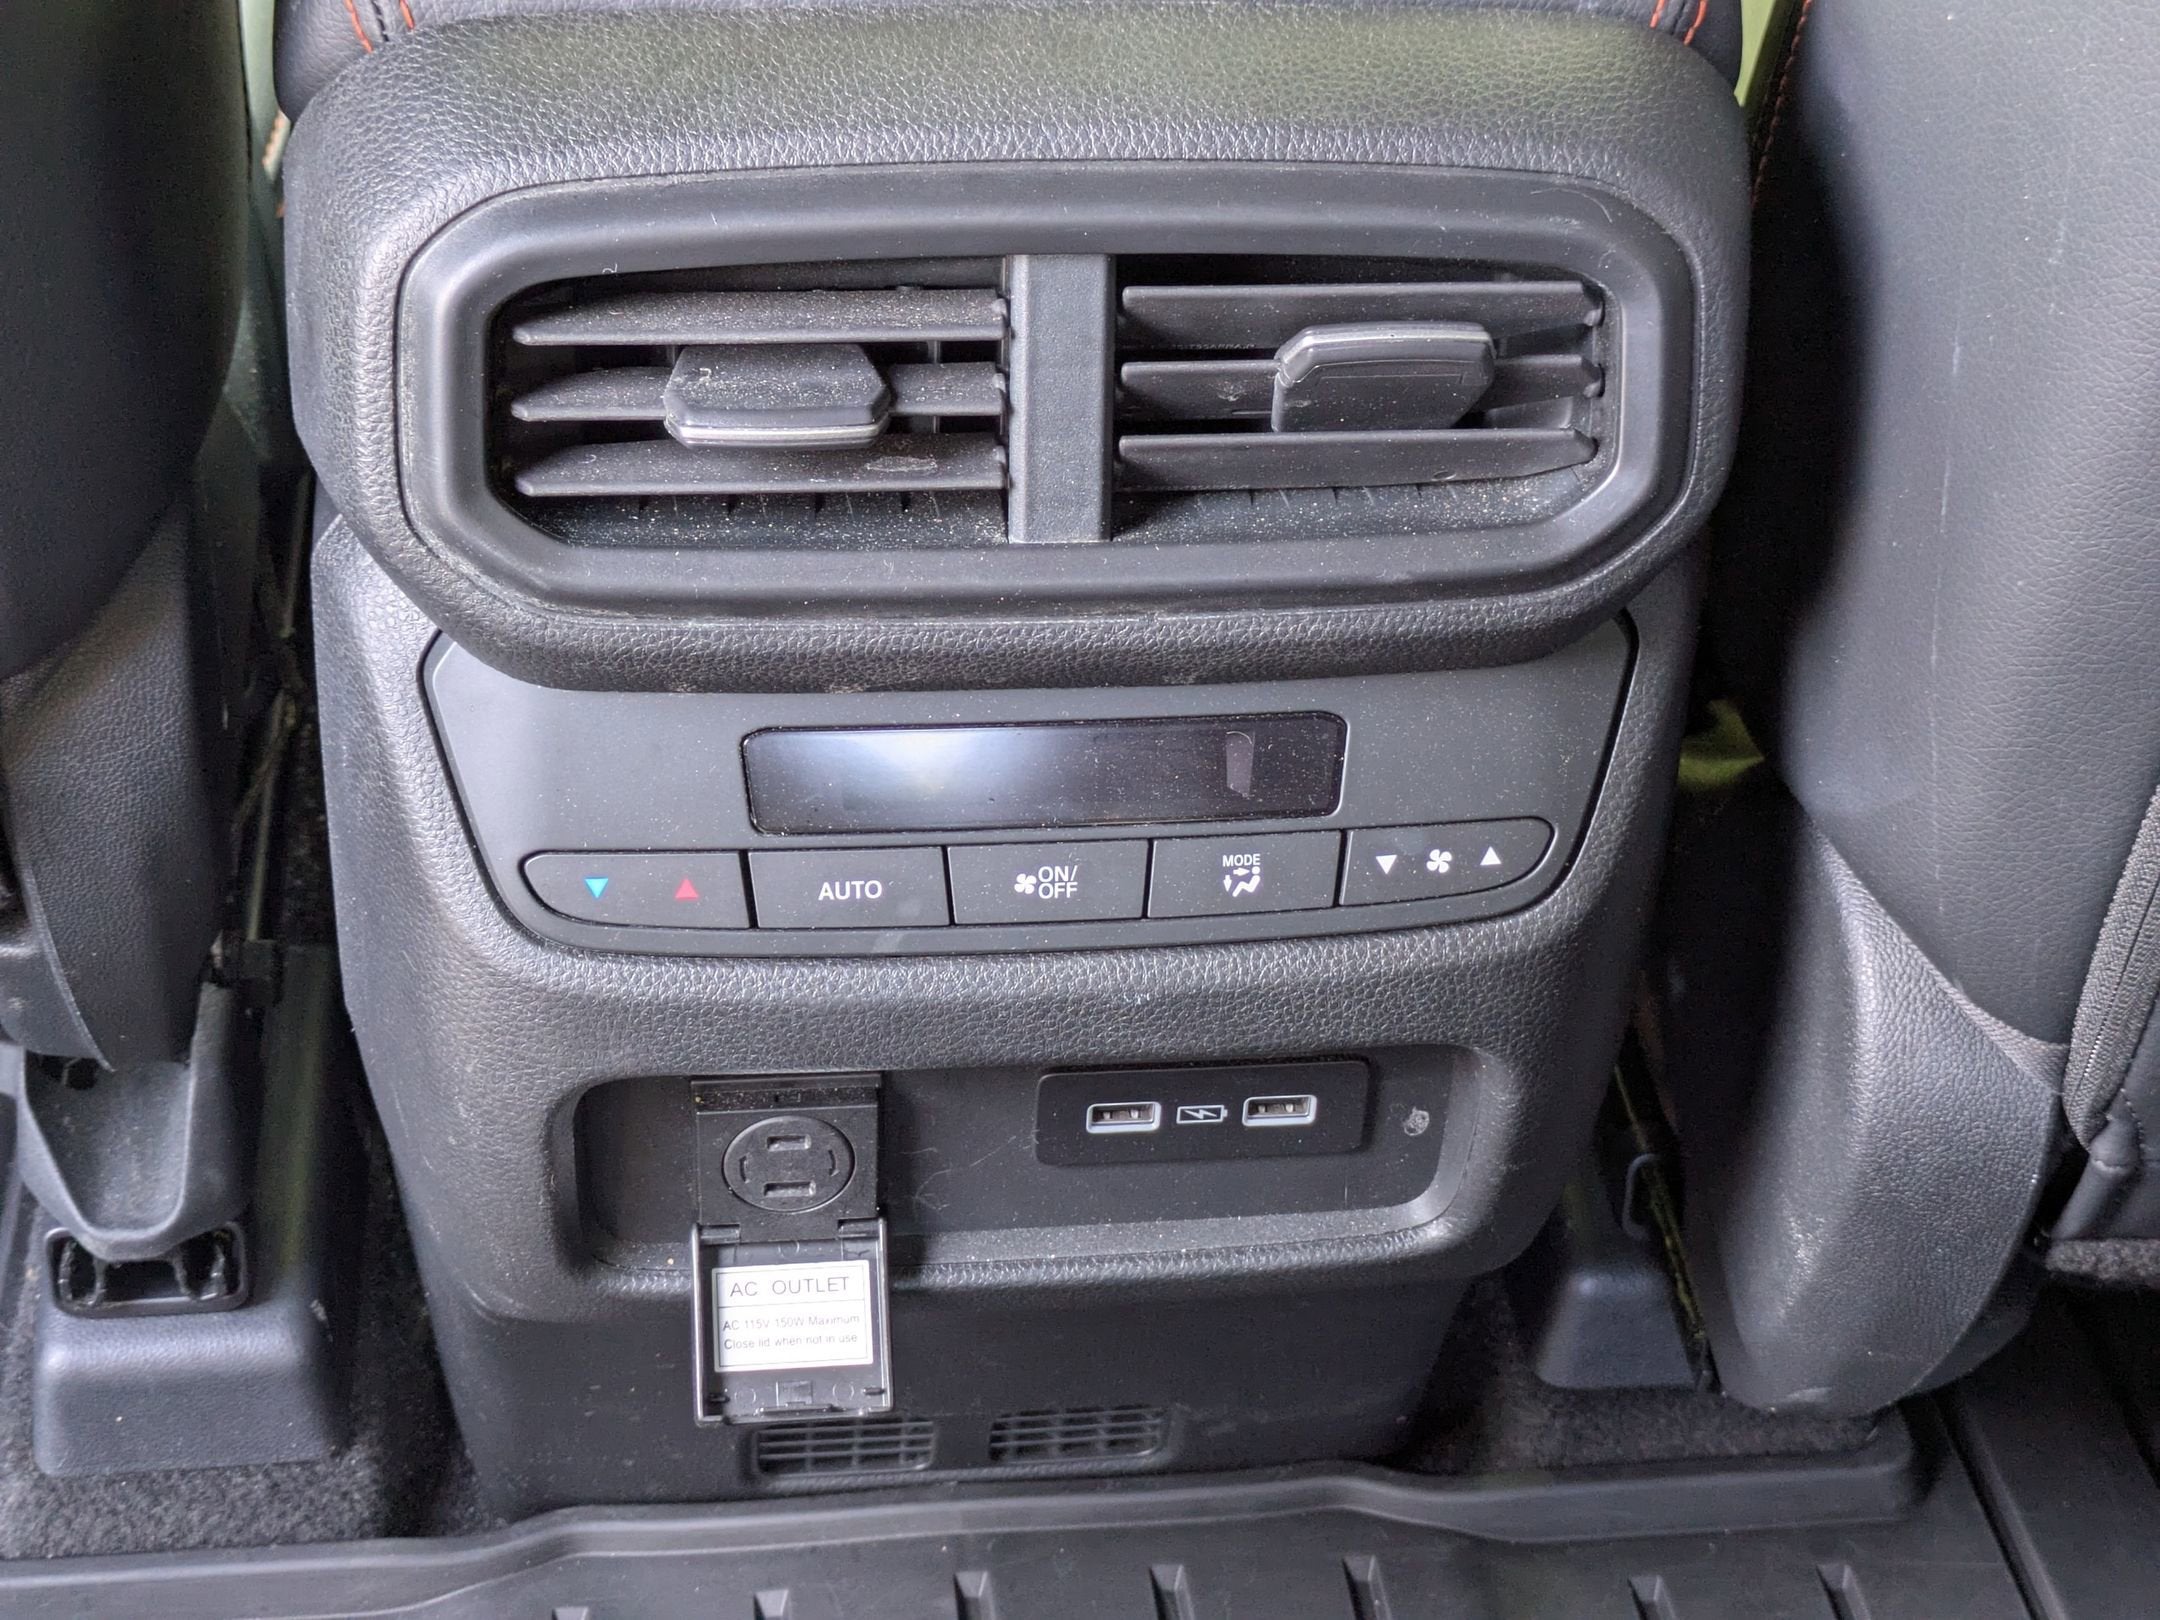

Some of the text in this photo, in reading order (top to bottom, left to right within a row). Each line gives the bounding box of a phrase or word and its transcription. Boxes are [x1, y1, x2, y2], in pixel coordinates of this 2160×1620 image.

[1222, 853, 1261, 867] MODE
[1038, 865, 1078, 882] ON/
[818, 880, 882, 900] AUTO
[1038, 882, 1078, 899] OFF
[730, 1276, 849, 1297] AC OUTLET
[722, 1319, 740, 1331] AC
[775, 1316, 804, 1328] 150W
[723, 1334, 858, 1350] Close lid when not in use
